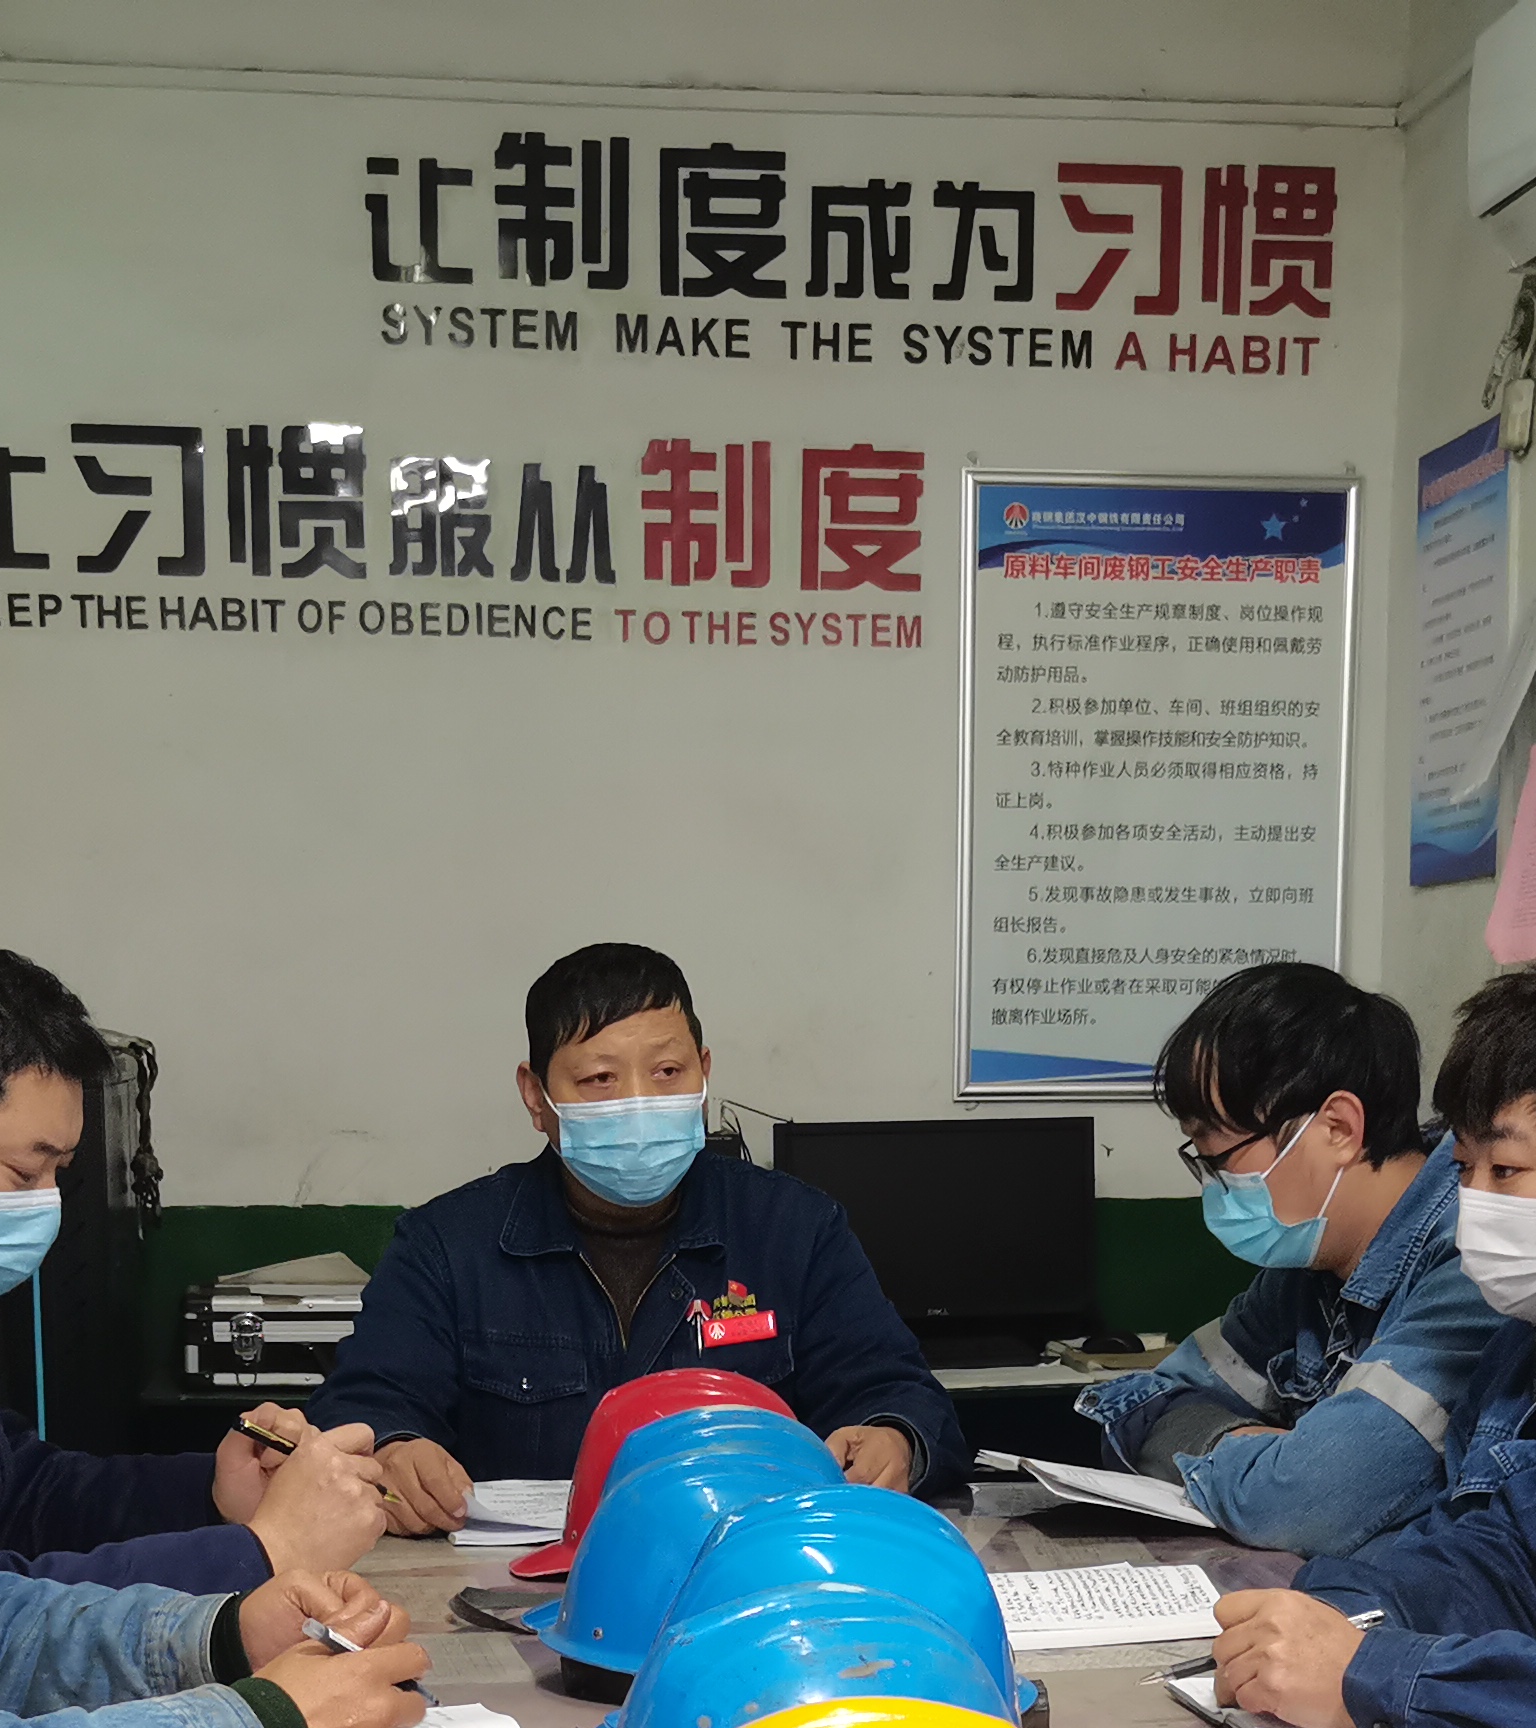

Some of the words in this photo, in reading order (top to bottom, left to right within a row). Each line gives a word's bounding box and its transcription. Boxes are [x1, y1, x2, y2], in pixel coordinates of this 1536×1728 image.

[365, 132, 1338, 317] 让制度成为习惯
[379, 305, 579, 352] SYSTEM
[614, 314, 751, 361] MAKE
[786, 322, 874, 364] THE
[904, 326, 1095, 370] SYSTEM
[1114, 332, 1145, 372] A
[1168, 334, 1321, 378] HABIT
[1003, 554, 1322, 583] 原料车间废钢工安全生产职责
[75, 593, 151, 632] THE
[158, 597, 285, 636] HABIT
[295, 600, 349, 638] OF
[358, 603, 593, 643] OBEDIENCE
[615, 607, 672, 646] TO
[682, 609, 761, 648] THE
[769, 611, 923, 650] SYSTEM
[1034, 602, 1324, 624] 1.遵守安全生产规章制度、岗位操作规
[996, 665, 1088, 684] 动防护用品。
[1031, 698, 1321, 718] 2.积极参加单位、车间、班组组织的安
[1031, 760, 1318, 781] 3.特种作业人员必须取得相应资格，持
[995, 792, 1054, 810] 证上岗。
[1029, 824, 1317, 843] 4.积极参加各项安全活动，主动提出安
[994, 854, 1086, 873] 全生产建议。
[1028, 886, 1315, 904] 5.发现事故隐患或发生事故，立即向班
[993, 916, 1068, 934] 组长报告。
[991, 1008, 1097, 1026] 撤离作业场所。
